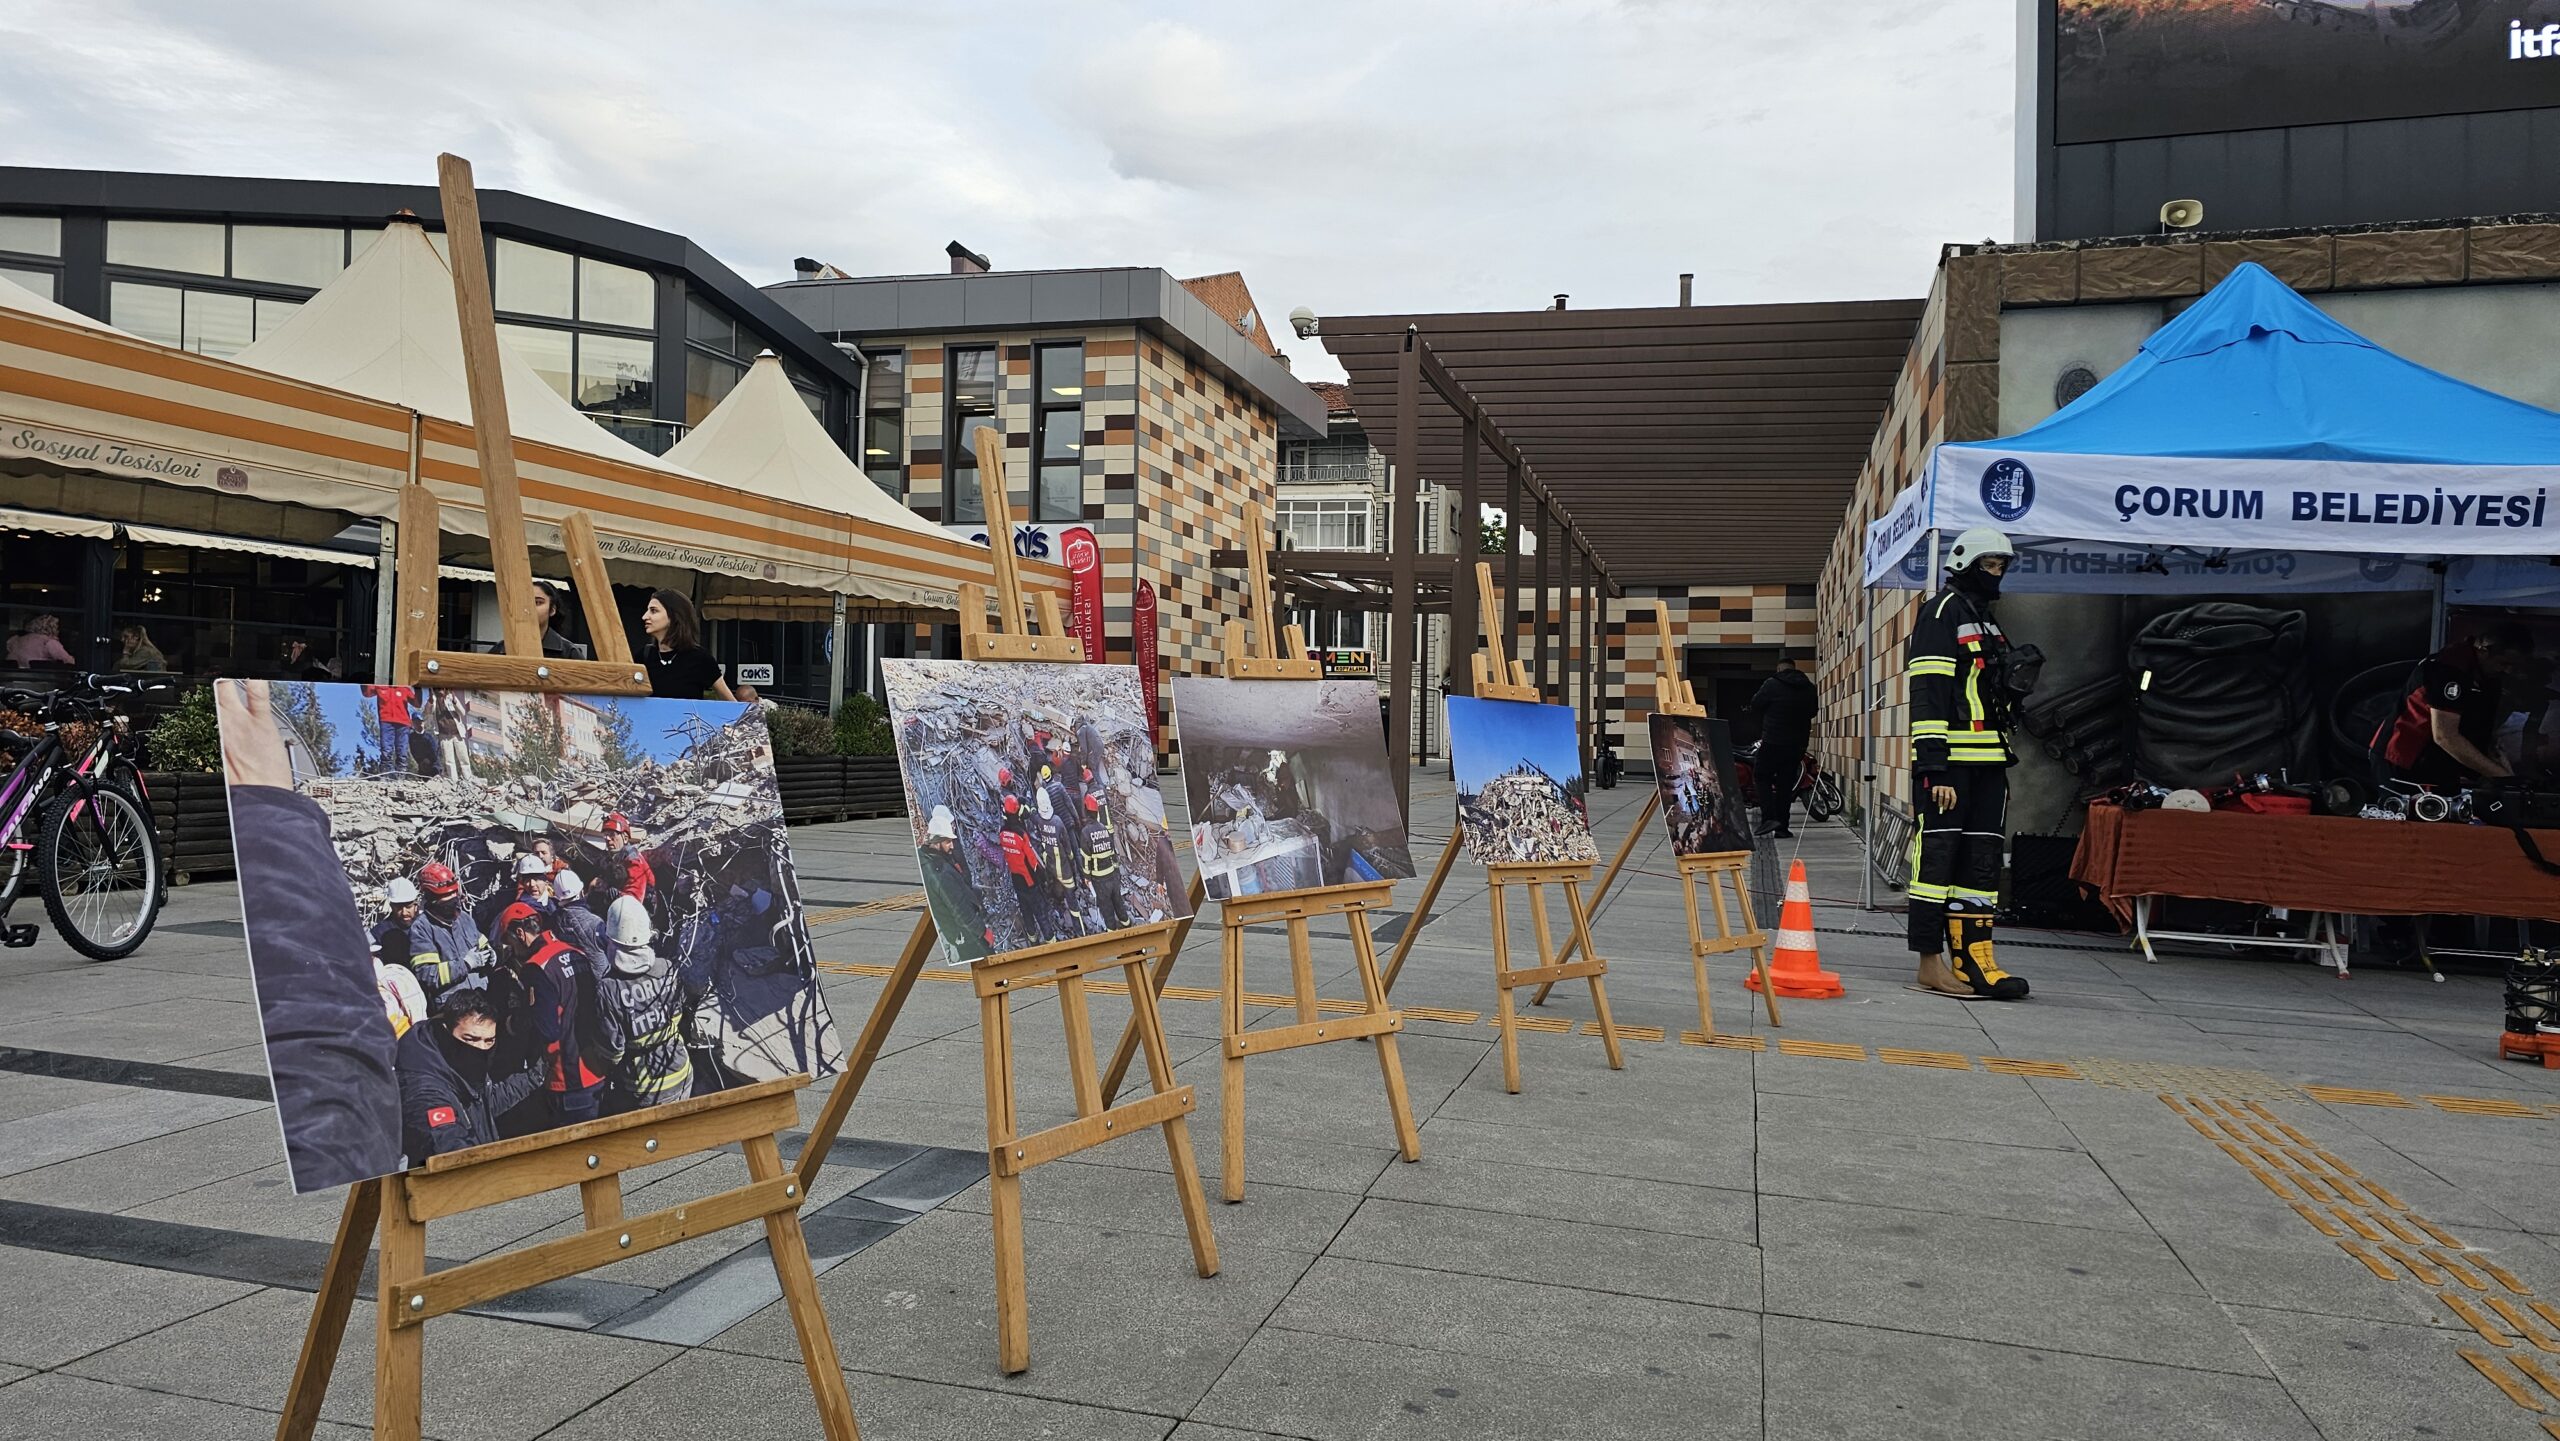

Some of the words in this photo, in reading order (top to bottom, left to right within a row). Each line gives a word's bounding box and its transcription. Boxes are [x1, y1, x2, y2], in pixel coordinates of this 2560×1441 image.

[12, 429, 101, 462] Sosyal
[106, 445, 201, 479] Tesisleri
[2114, 484, 2264, 522] ÇORUM
[2291, 487, 2547, 528] BELEDİYESİ
[617, 539, 677, 560] Belediyesi
[679, 549, 717, 567] Sosyal
[716, 555, 758, 574] Tesisleri
